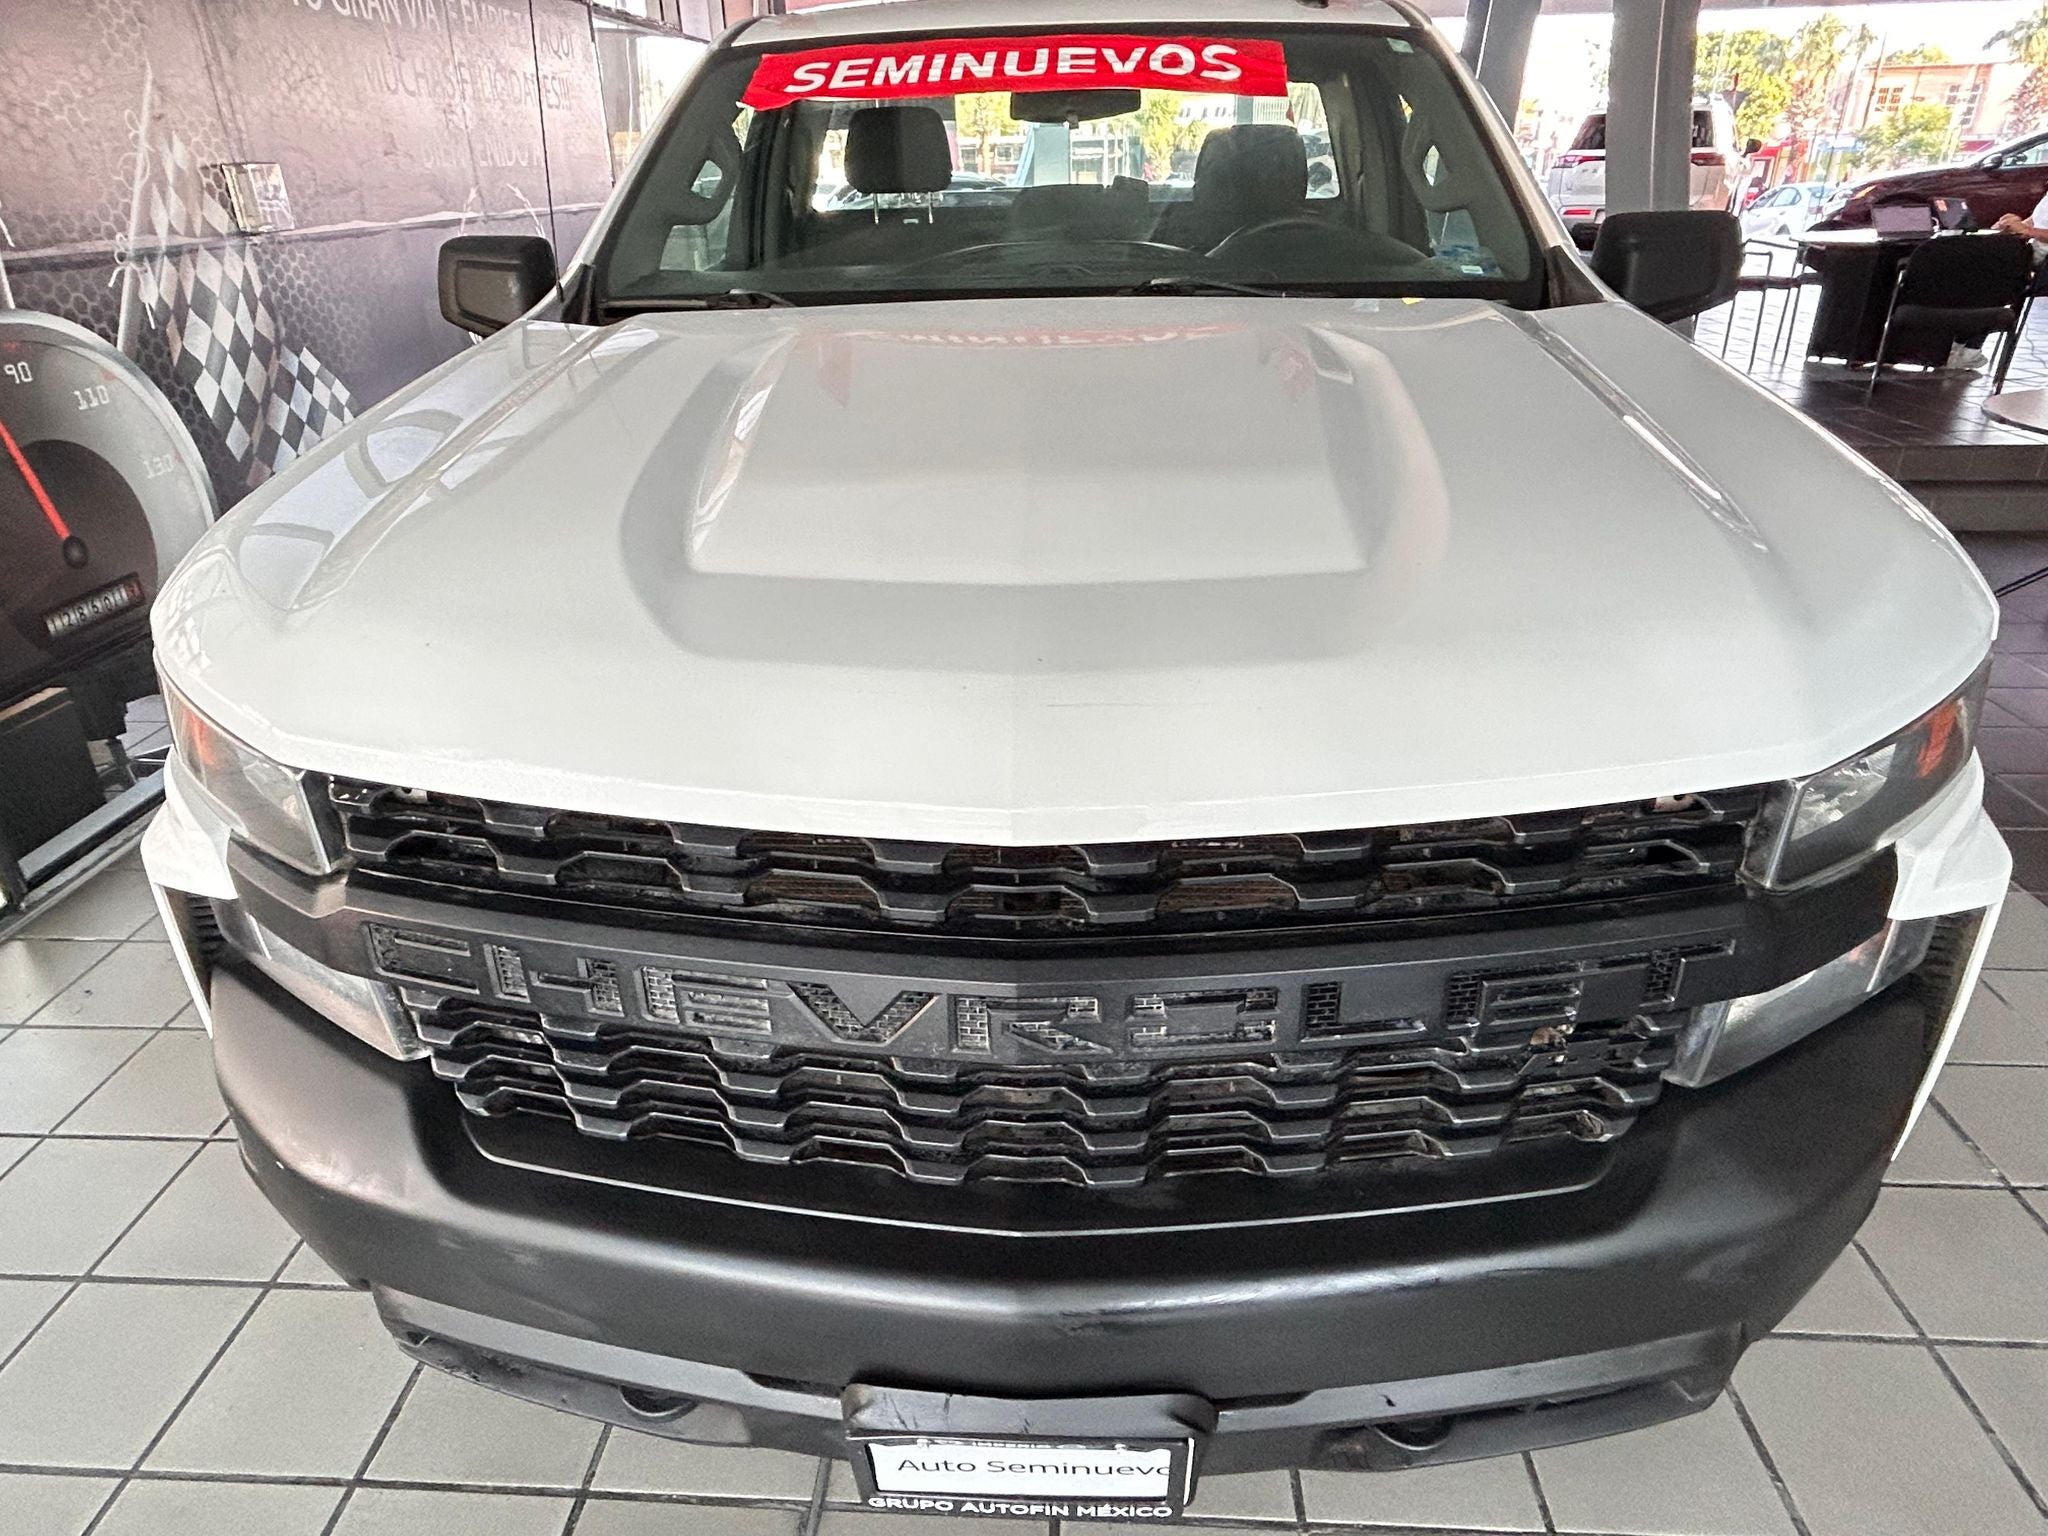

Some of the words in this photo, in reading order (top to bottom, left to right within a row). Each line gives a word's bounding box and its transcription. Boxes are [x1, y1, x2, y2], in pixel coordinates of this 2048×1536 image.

[364, 56, 456, 100] MUCHAS
[783, 44, 1242, 93] SEMINUEVOS
[3, 361, 33, 384] 90
[72, 385, 110, 411] 110
[363, 922, 1737, 1053] CHEVROLET
[898, 1459, 976, 1473] Auto
[868, 1497, 954, 1512] GRUPO
[960, 1502, 1069, 1517] AUTOFIN
[1076, 1503, 1173, 1518] MÉXICO
